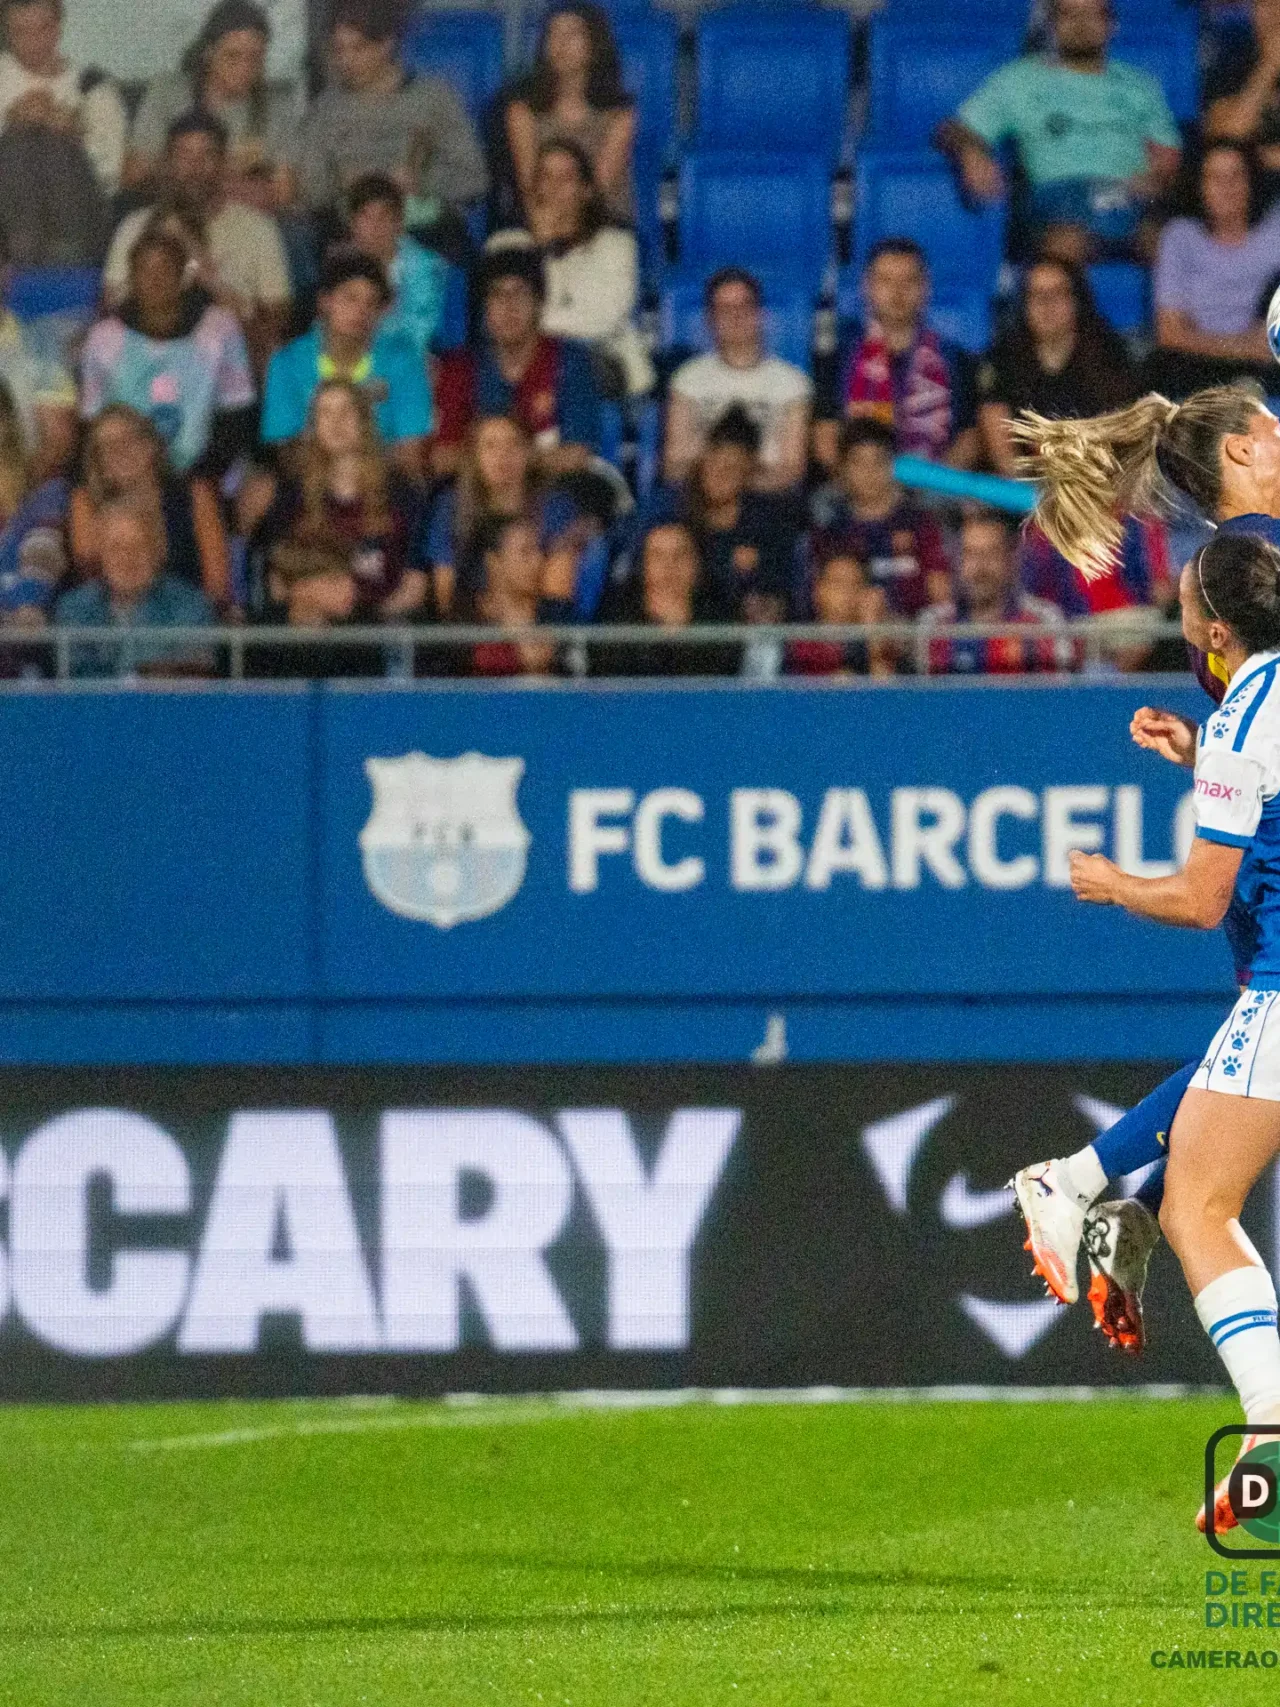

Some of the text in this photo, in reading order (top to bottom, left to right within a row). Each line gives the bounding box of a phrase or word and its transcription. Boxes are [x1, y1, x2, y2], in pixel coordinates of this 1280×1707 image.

[568, 785, 1199, 893] FC BARCEL
[0, 1104, 744, 1358] CARY
